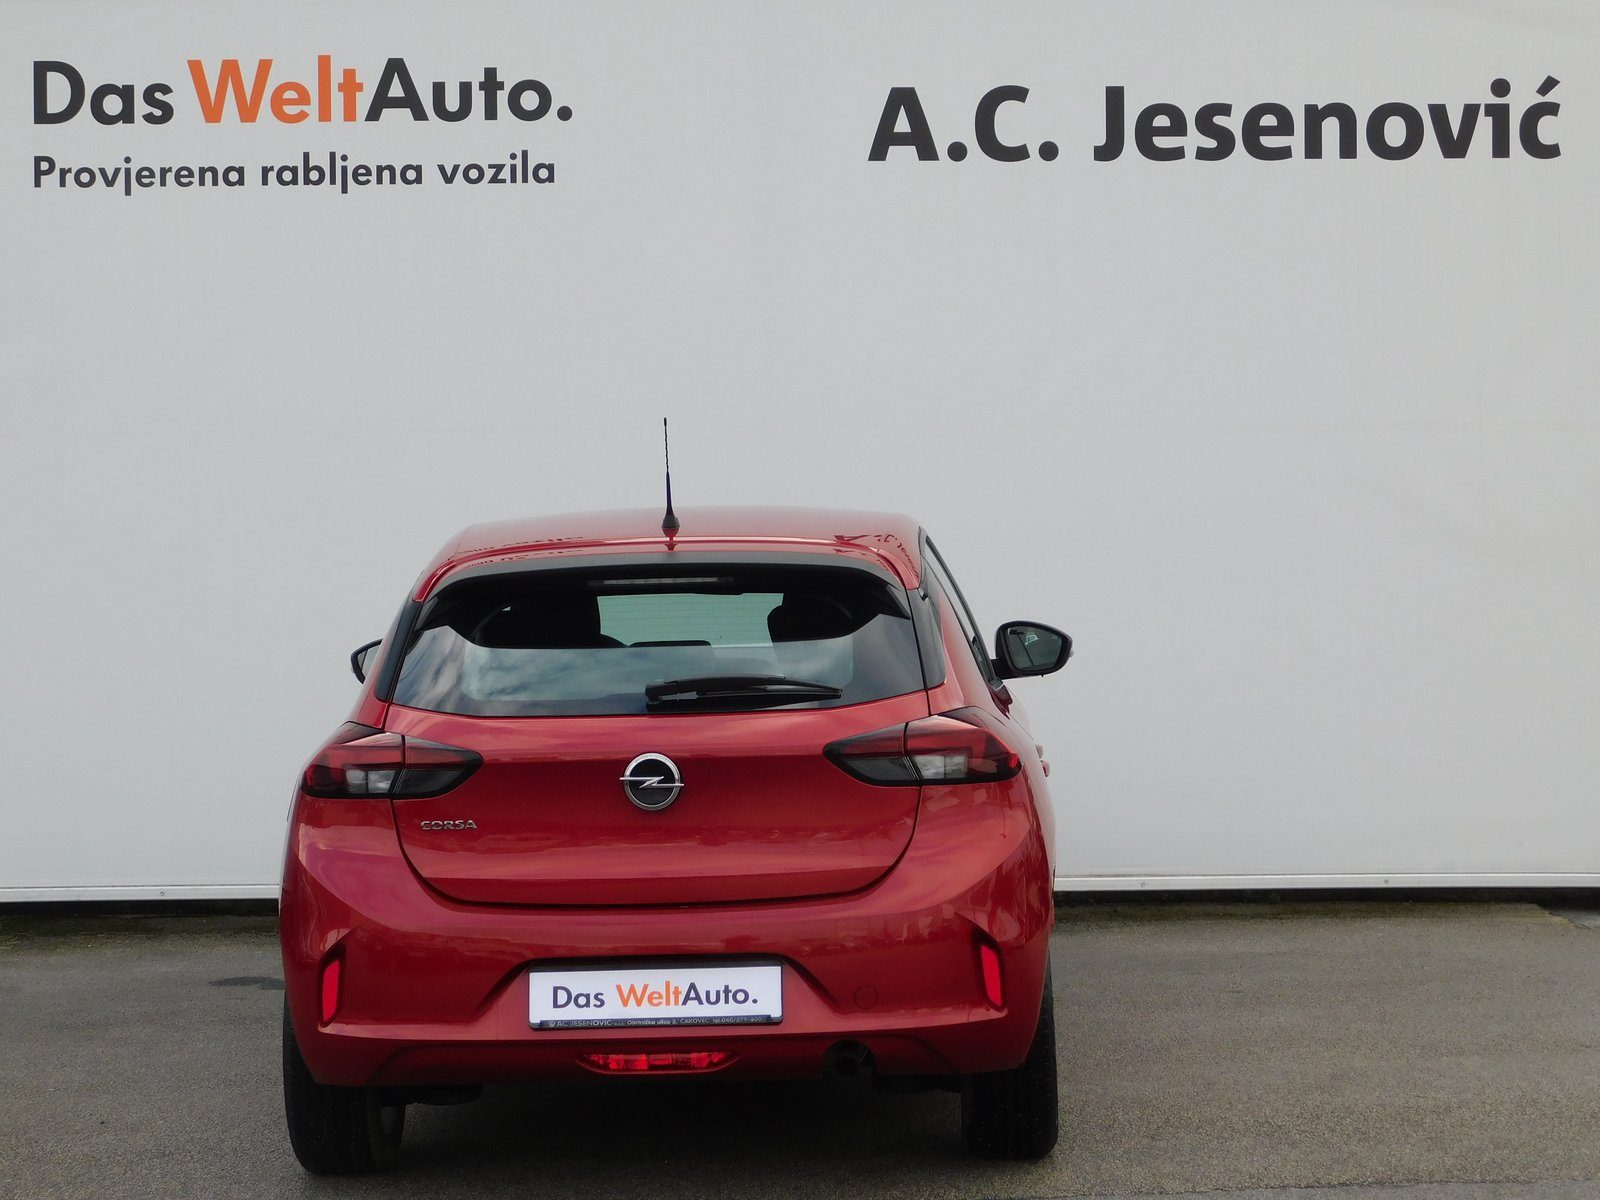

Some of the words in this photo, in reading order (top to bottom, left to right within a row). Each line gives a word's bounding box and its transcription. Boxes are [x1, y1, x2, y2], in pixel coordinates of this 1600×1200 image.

[34, 61, 175, 126] Das
[187, 55, 573, 125] WeltAuto.
[868, 85, 1060, 163] A.C.
[1094, 75, 1563, 163] Jesenović
[34, 156, 246, 197] Provjerena
[262, 152, 424, 195] rabljena
[437, 150, 556, 186] vozila
[420, 819, 478, 830] CORSA
[553, 986, 606, 1009] Das
[616, 981, 759, 1008] WeltAuto.
